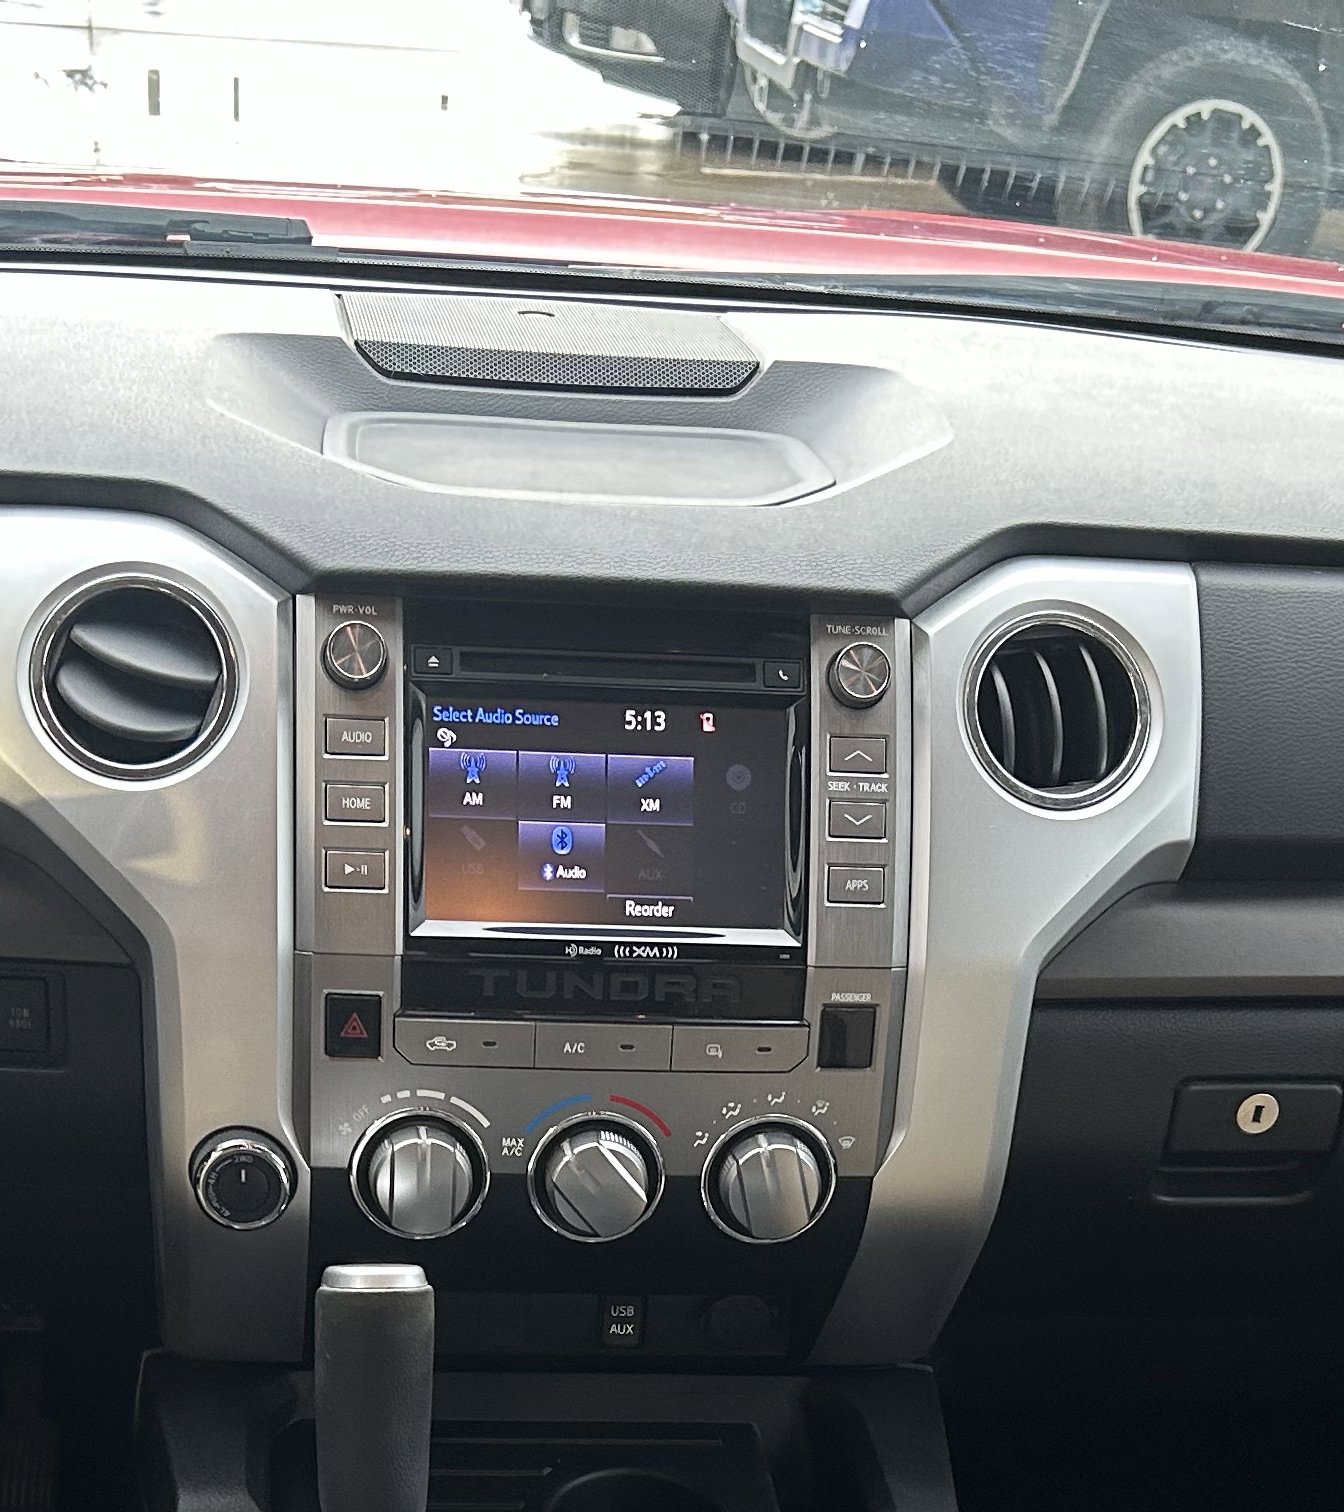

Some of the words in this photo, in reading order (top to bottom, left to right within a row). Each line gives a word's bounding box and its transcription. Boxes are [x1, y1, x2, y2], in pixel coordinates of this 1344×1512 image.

[432, 705, 473, 723] Select
[475, 706, 513, 725] Audio
[515, 708, 560, 727] Source
[624, 709, 666, 731] 5:13
[341, 730, 372, 743] AUDIO
[827, 781, 851, 792] SEEK
[858, 782, 889, 793] TRACK
[341, 797, 371, 810] HOME
[462, 792, 483, 807] AM
[552, 795, 572, 810] FM
[640, 797, 661, 812] XM
[556, 865, 587, 880] Audio
[845, 879, 869, 892] APPS
[625, 900, 675, 917] Reorder
[578, 945, 602, 955] Radio
[469, 968, 741, 1003] TUNDRA
[563, 1042, 586, 1053] A/C
[502, 1137, 525, 1147] MAX
[501, 1147, 523, 1157] A/C
[610, 1305, 635, 1317] USB
[609, 1323, 635, 1335] AUX
